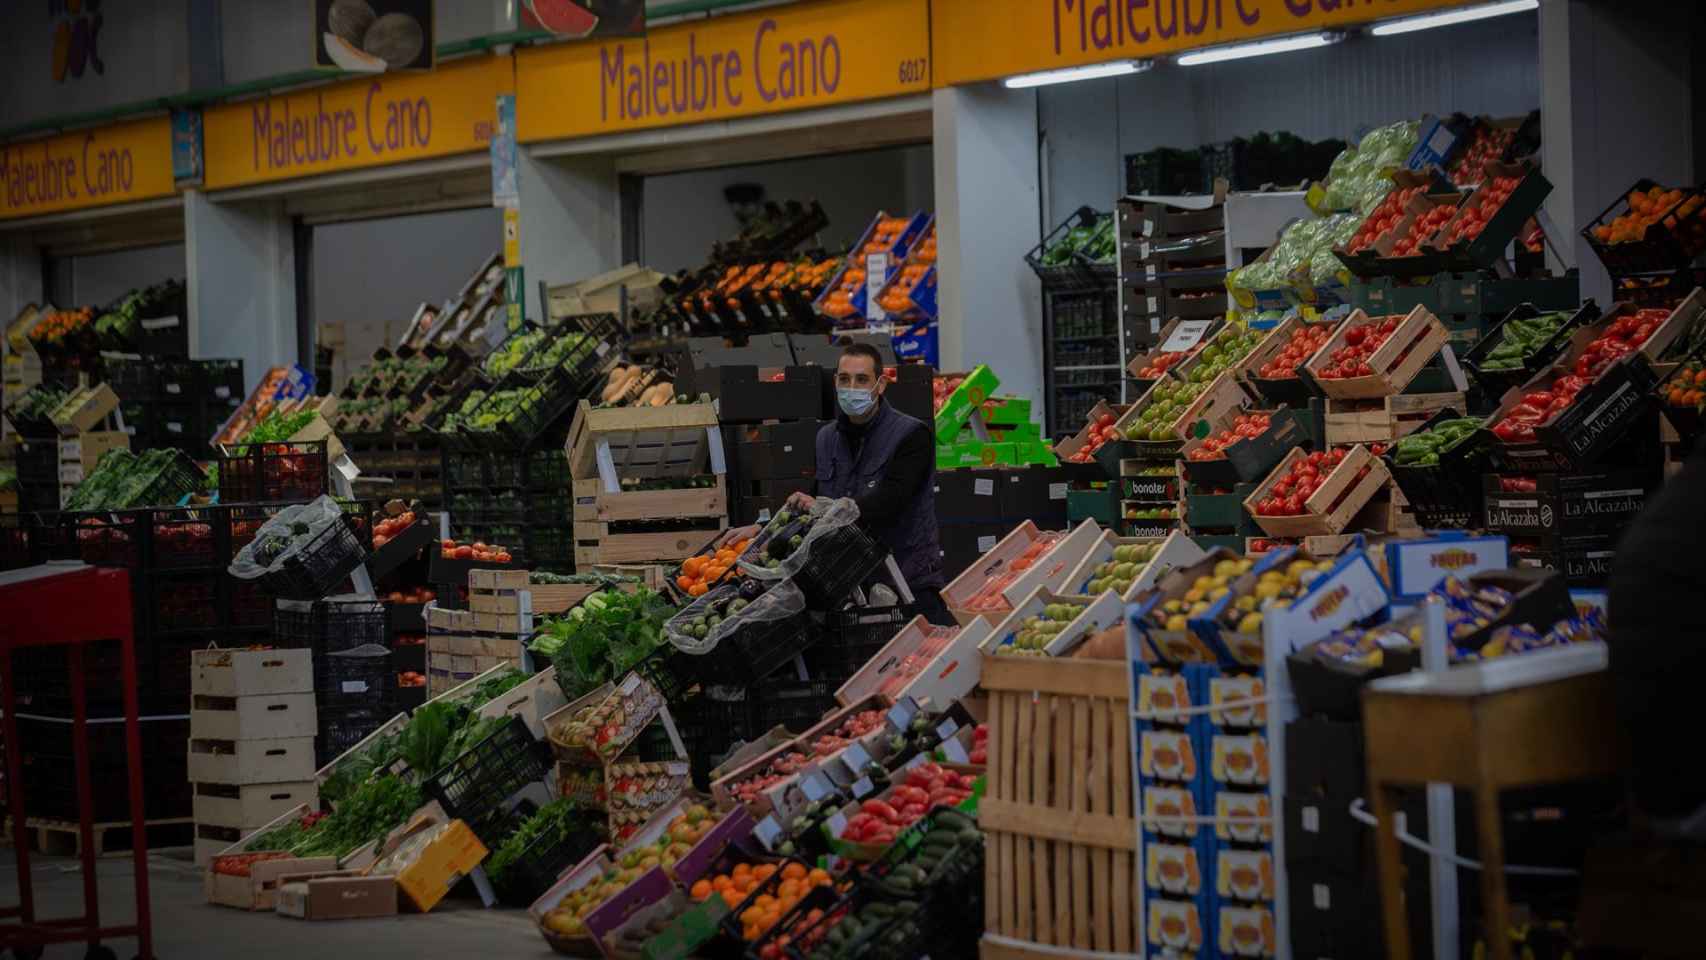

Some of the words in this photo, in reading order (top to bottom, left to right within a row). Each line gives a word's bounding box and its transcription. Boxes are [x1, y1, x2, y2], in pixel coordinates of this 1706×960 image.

[599, 32, 741, 121] Maleubre
[753, 19, 840, 102] Cano
[899, 58, 926, 83] 6017
[252, 94, 358, 172] Maleubre
[364, 82, 432, 155] Cano
[83, 128, 134, 197] Cano
[1487, 508, 1500, 526] La
[1501, 508, 1540, 526] Alcazaba
[1565, 501, 1580, 516] La
